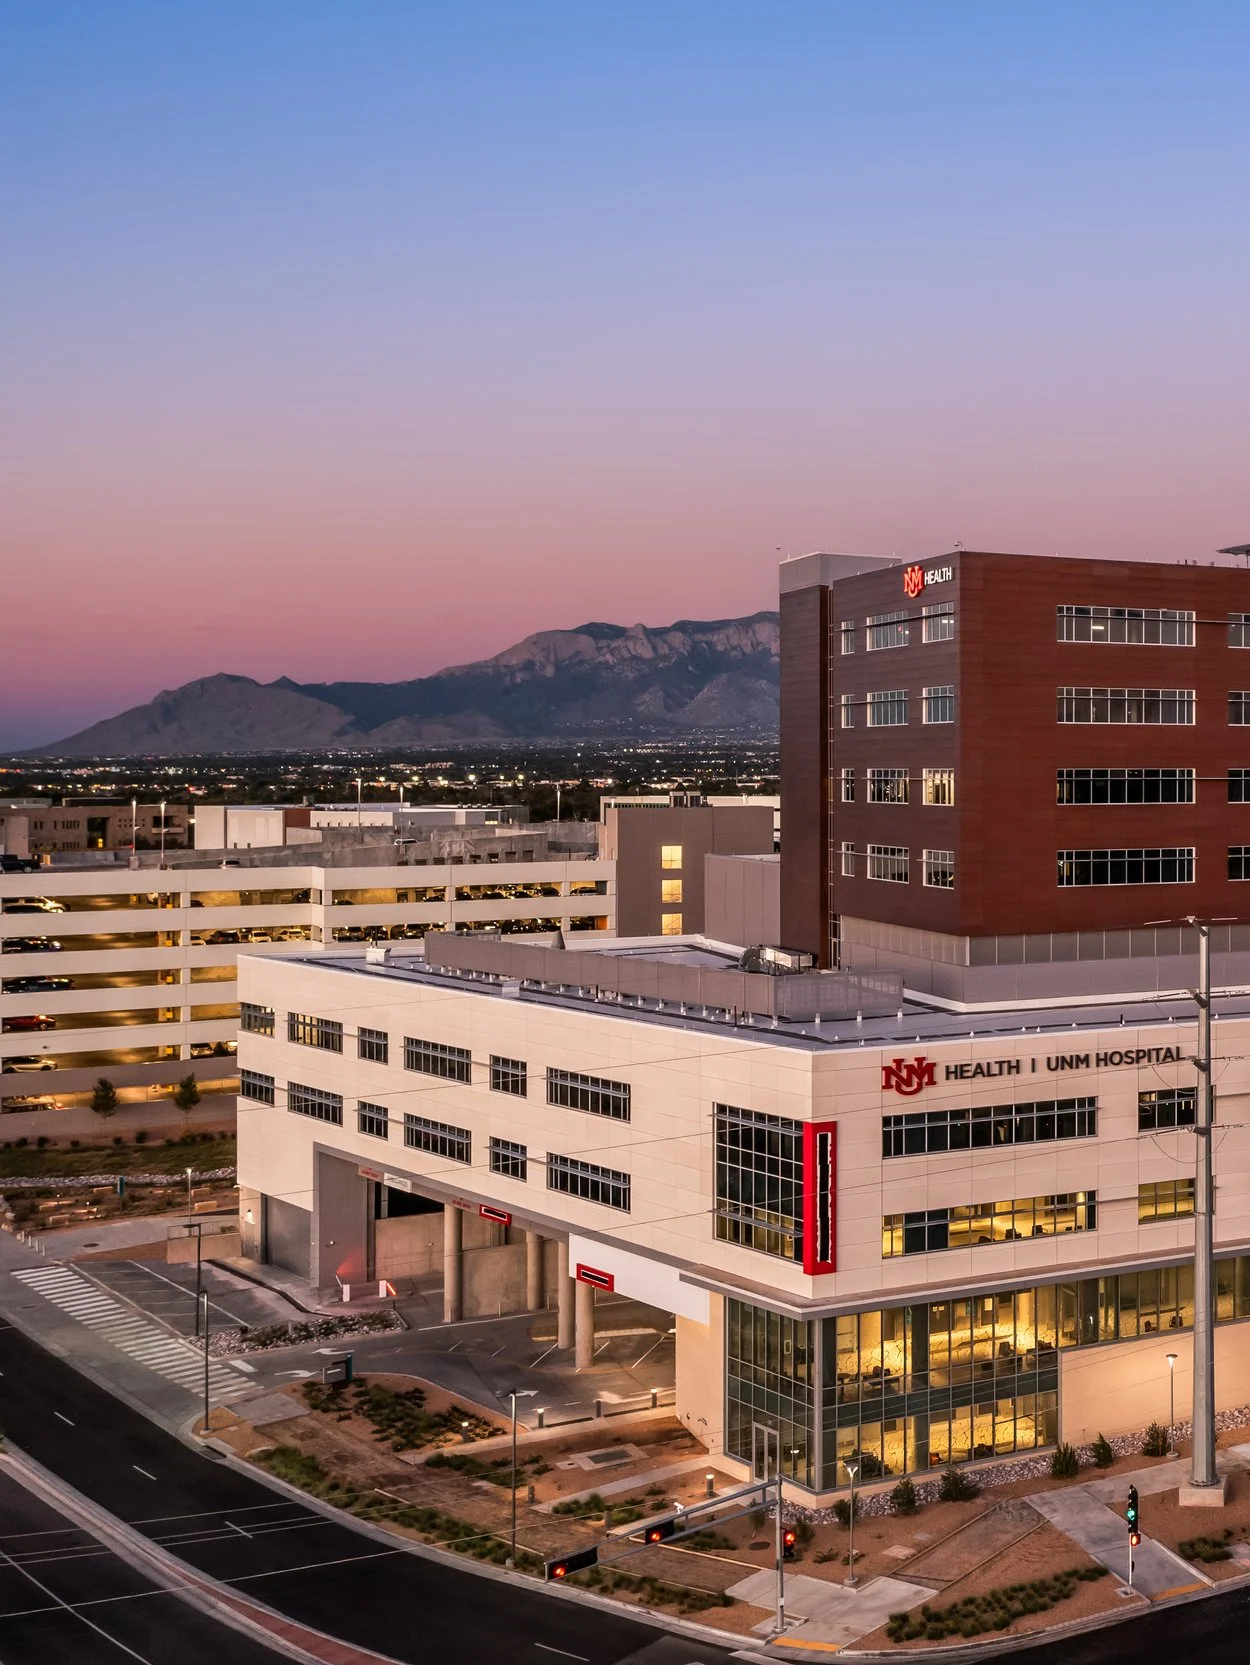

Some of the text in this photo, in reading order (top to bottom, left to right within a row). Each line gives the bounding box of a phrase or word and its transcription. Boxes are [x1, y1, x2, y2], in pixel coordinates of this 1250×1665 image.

[924, 567, 952, 585] HEALTH
[945, 1059, 1020, 1081] HEALTH
[1047, 1054, 1090, 1072] UNM
[1095, 1046, 1186, 1068] HOSPITAL
